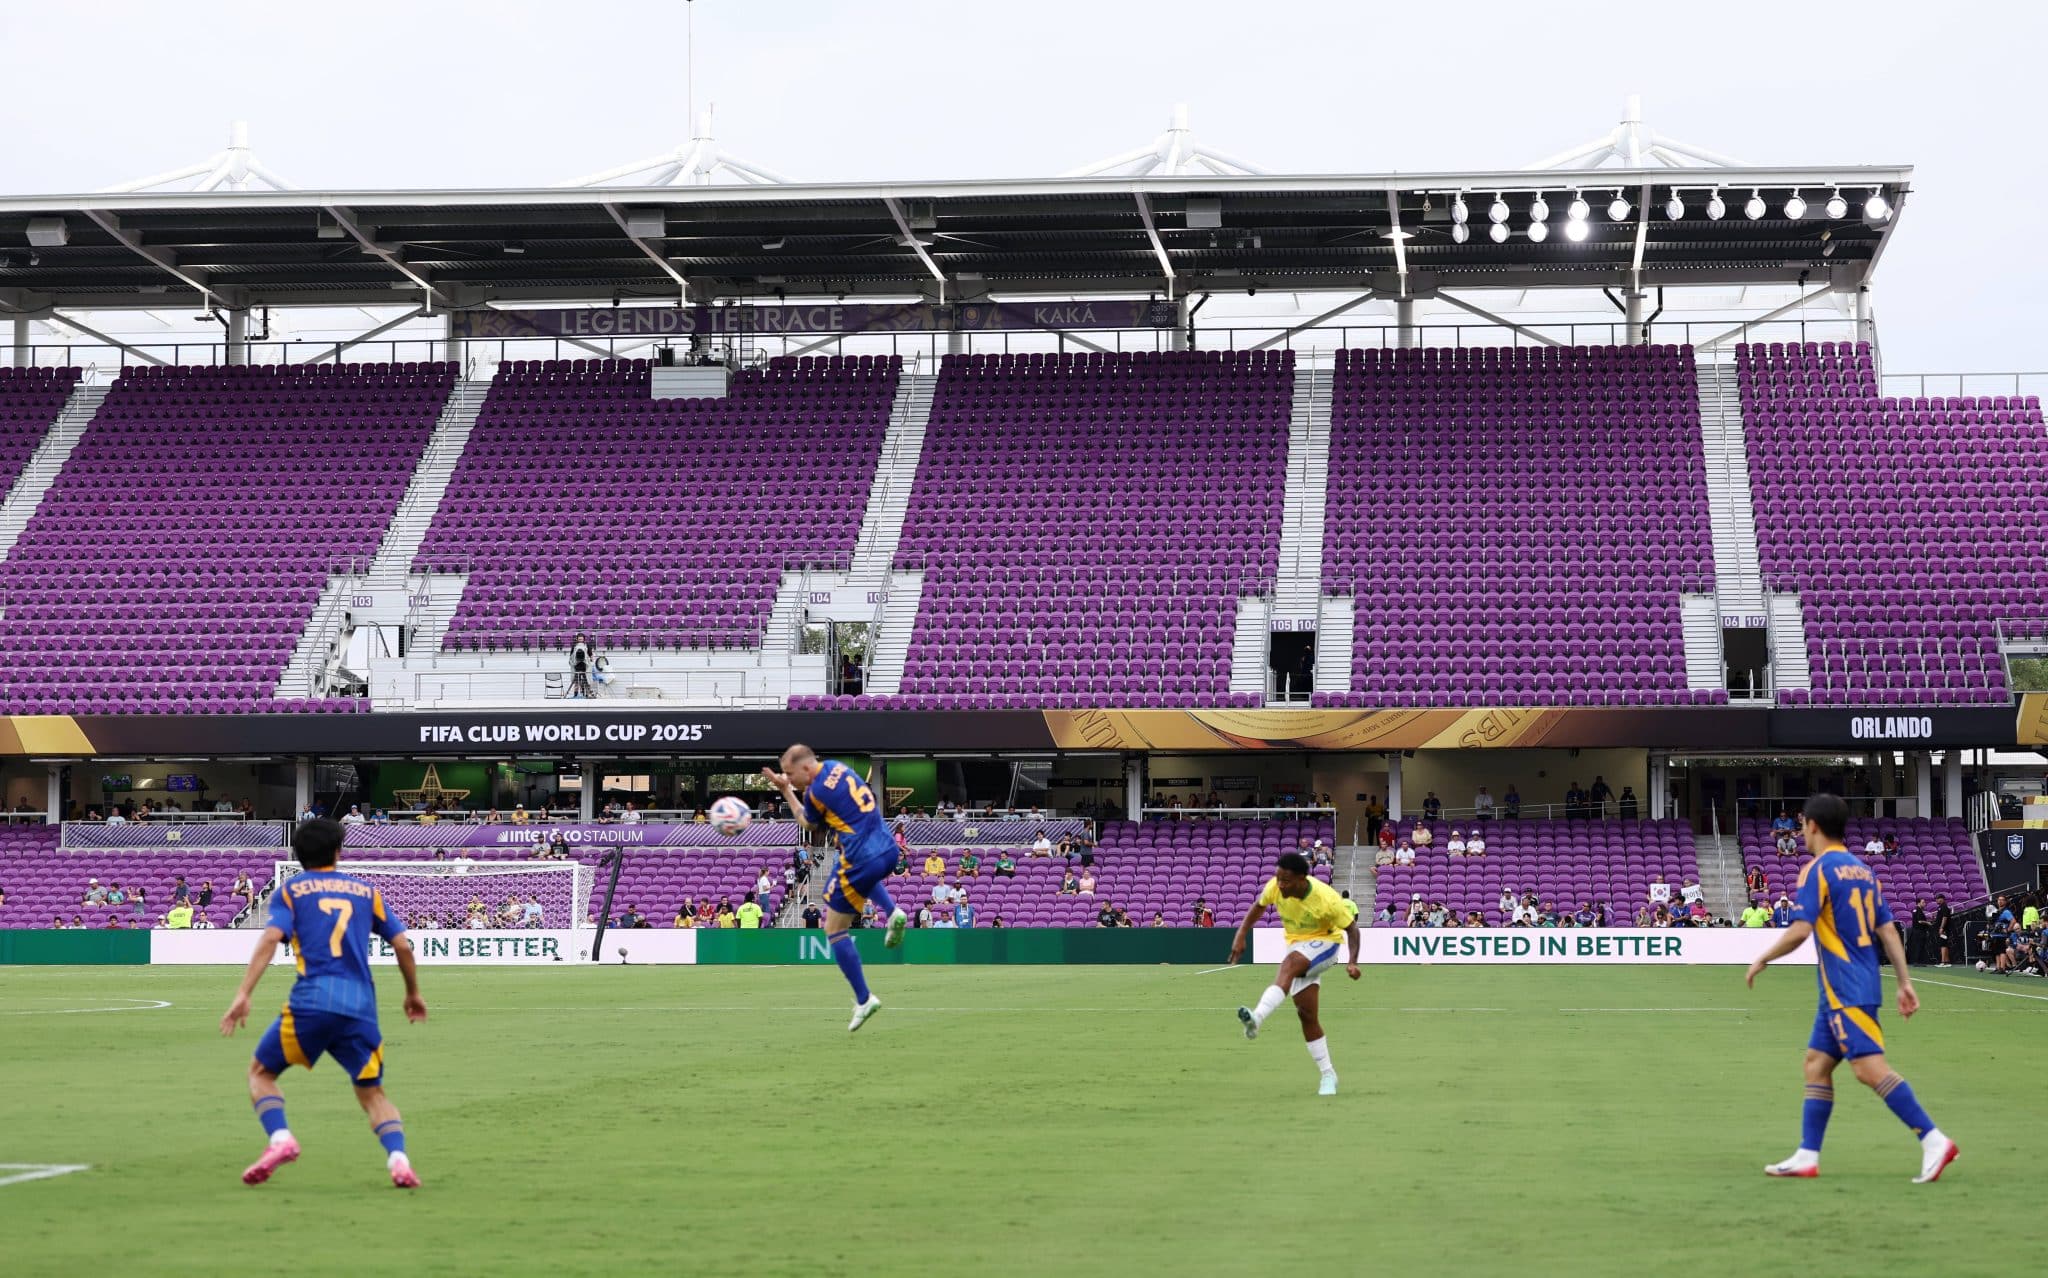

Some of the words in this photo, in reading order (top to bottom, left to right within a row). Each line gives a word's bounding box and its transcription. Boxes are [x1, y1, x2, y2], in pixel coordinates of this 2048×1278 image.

[560, 309, 696, 335] LEGENDS
[707, 307, 844, 332] TERRACE
[1034, 304, 1097, 324] KAKÁ
[353, 596, 372, 606] 103
[810, 592, 831, 603] 104
[1272, 620, 1291, 630] 105
[1299, 620, 1317, 630] 106
[1722, 617, 1739, 627] 06
[1746, 617, 1766, 627] 107
[420, 725, 464, 742] FIFA
[468, 725, 521, 742] CLUB
[525, 725, 600, 742] WORLD
[605, 725, 647, 741] CUP
[1851, 717, 1932, 738] ORLANDO
[845, 775, 876, 812] 6
[583, 830, 643, 842] STADIUM
[1849, 887, 1876, 947] 11
[318, 897, 353, 958] 7
[423, 937, 449, 957] IN
[458, 937, 559, 957] BETTER
[1393, 936, 1531, 956] INVESTED
[1539, 936, 1567, 956] IN
[1577, 936, 1682, 956] BETTER
